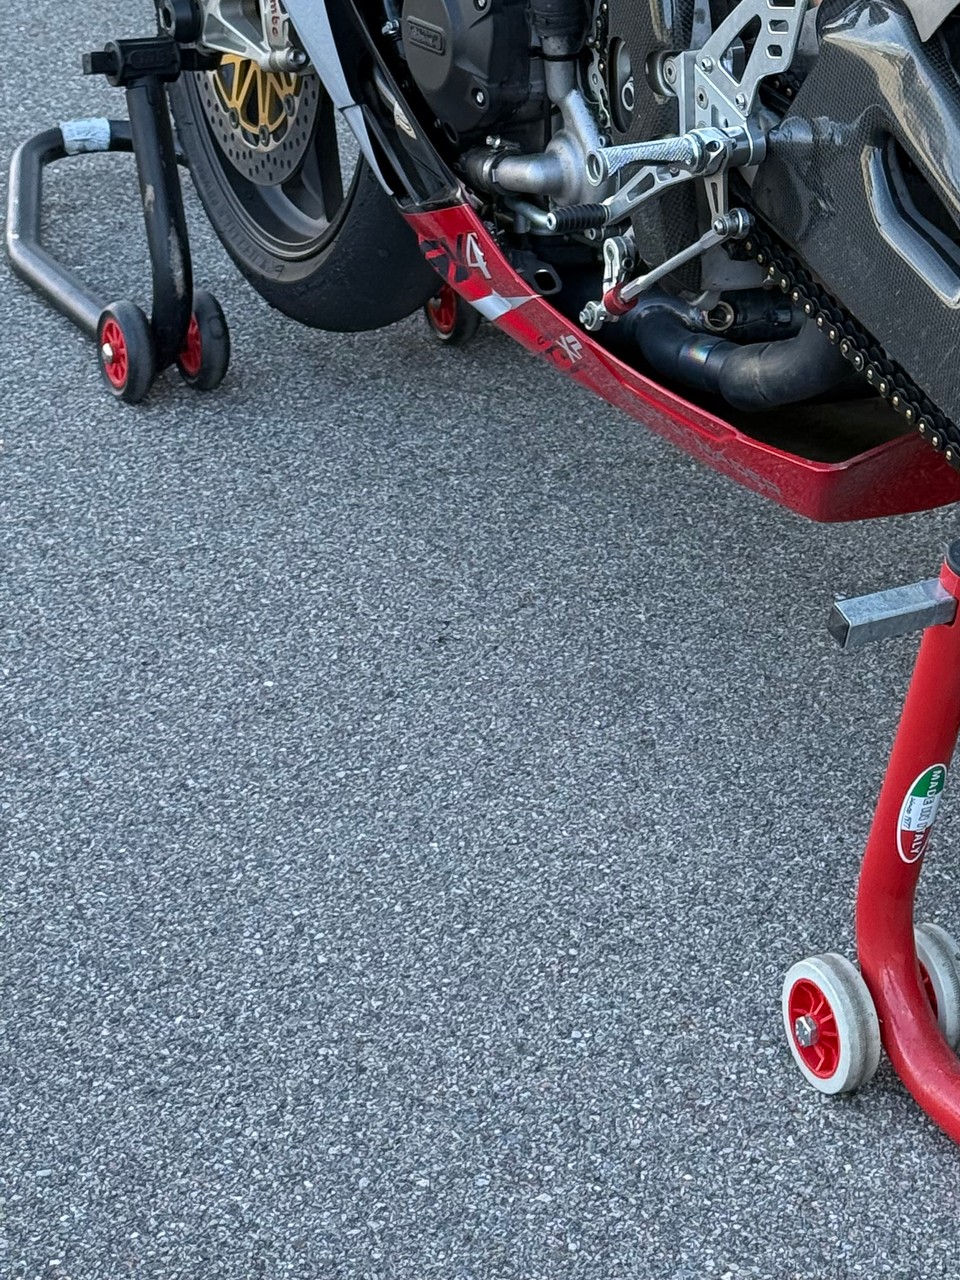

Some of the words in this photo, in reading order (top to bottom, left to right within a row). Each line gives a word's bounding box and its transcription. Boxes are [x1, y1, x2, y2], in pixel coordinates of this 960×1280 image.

[922, 769, 943, 806] MADE
[919, 806, 933, 820] IN
[910, 821, 927, 854] ITALY
